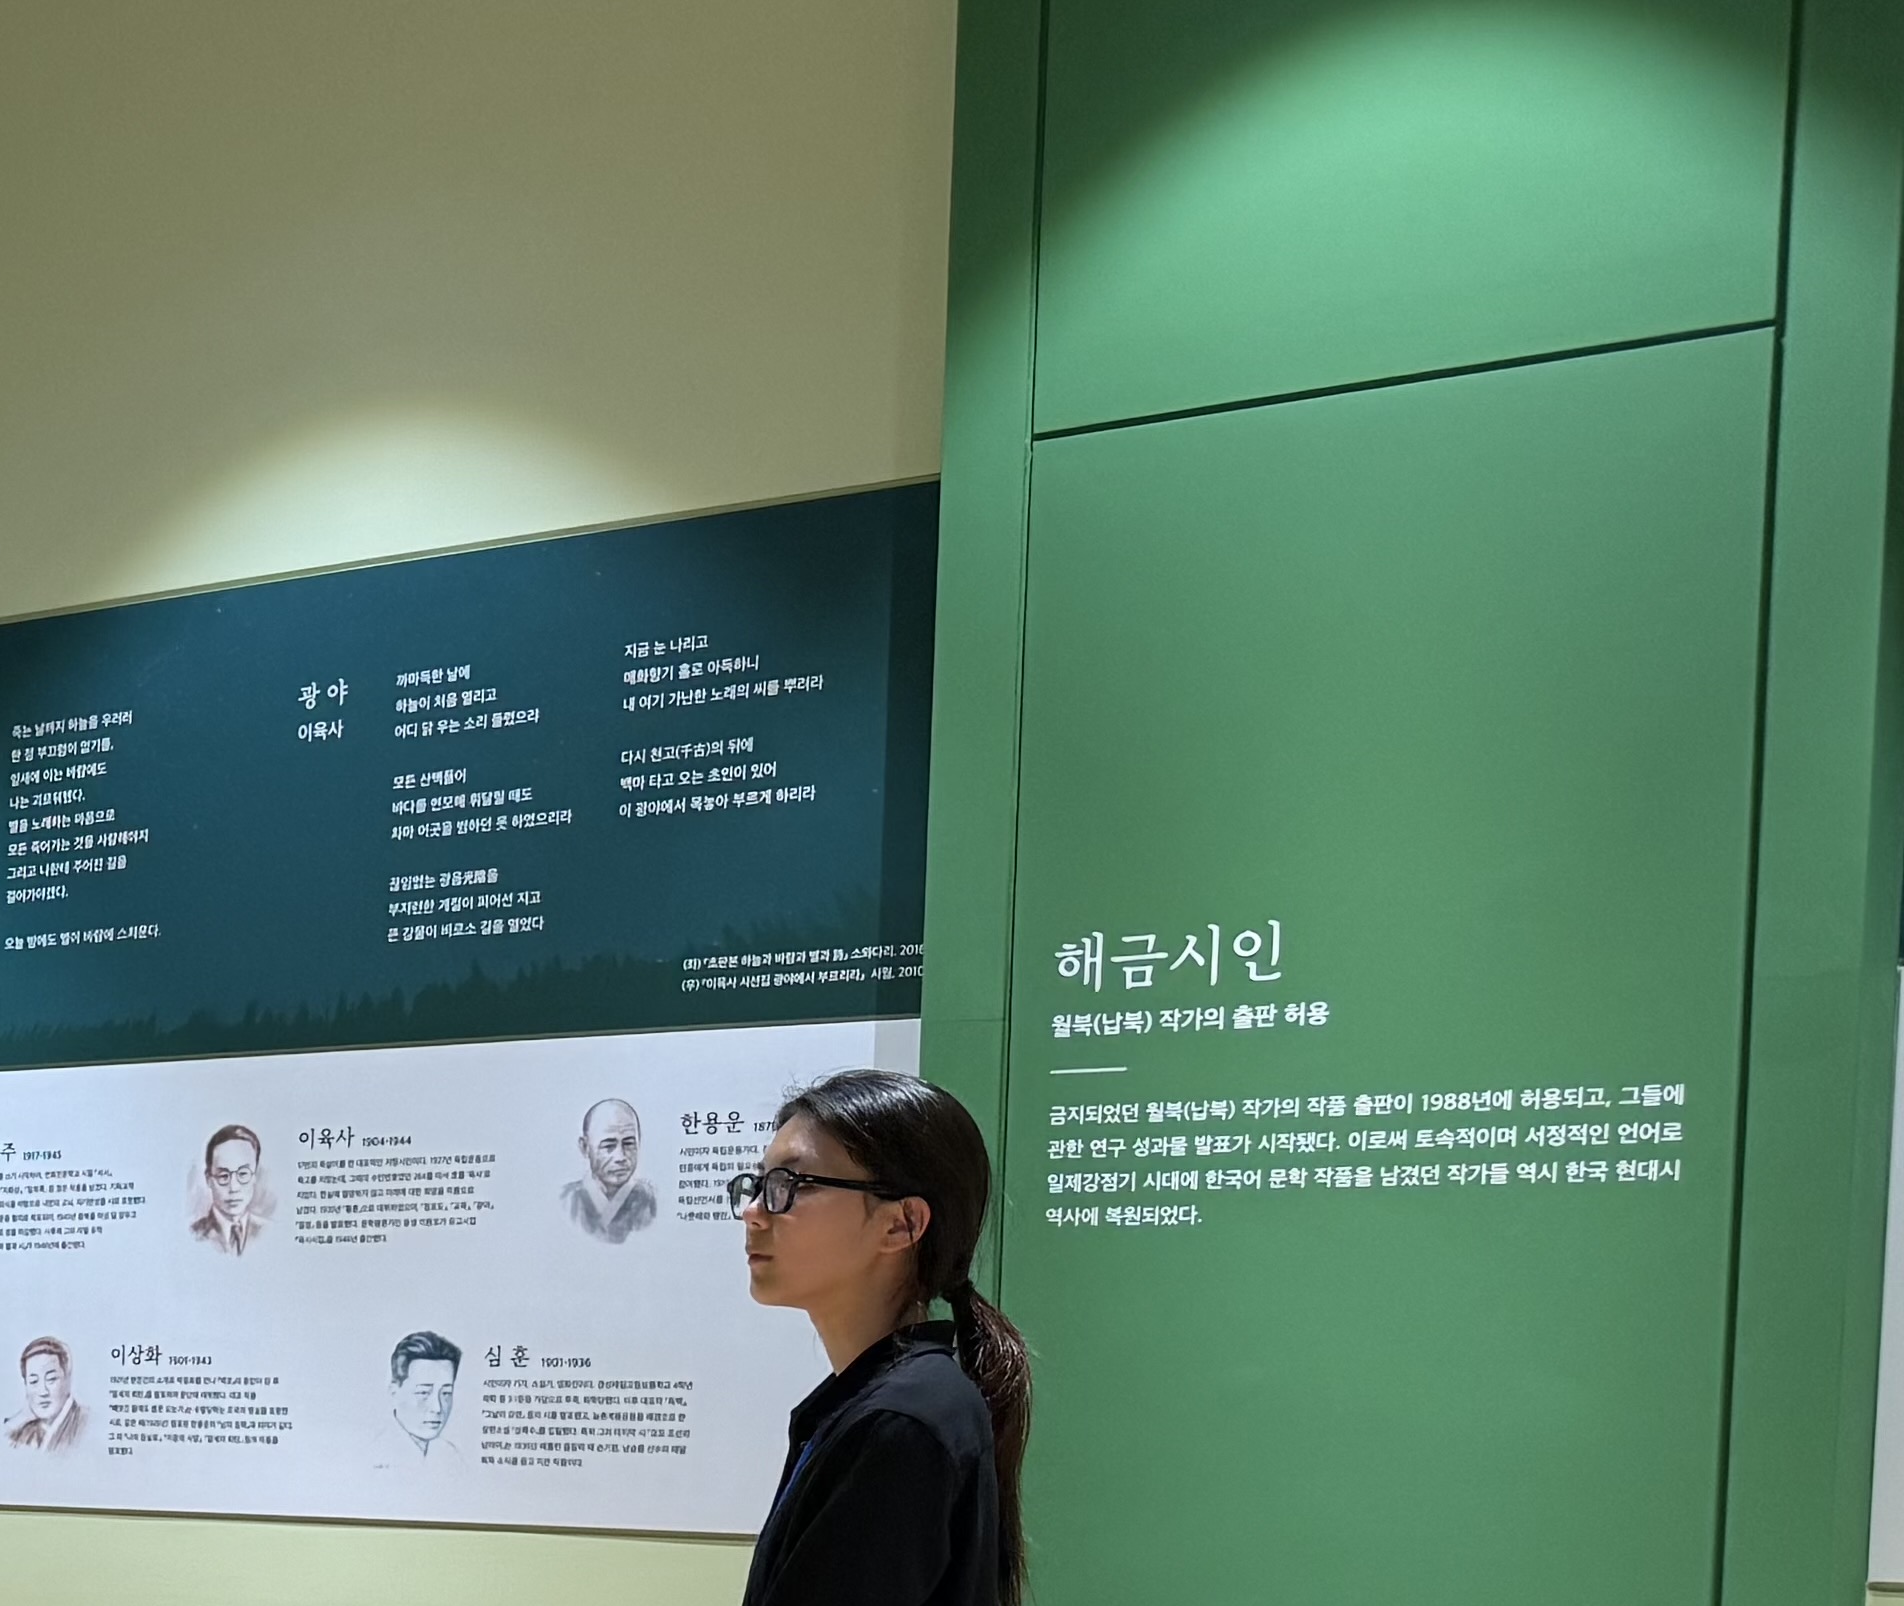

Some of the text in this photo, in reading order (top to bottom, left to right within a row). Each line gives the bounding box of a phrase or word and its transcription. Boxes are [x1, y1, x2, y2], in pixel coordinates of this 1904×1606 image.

[625, 635, 708, 658] 지금 눈 나리고
[396, 664, 470, 688] 까마득한 날에
[679, 662, 703, 680] 홀로
[708, 654, 759, 676] 아득하니
[297, 678, 349, 710] 광 야
[396, 688, 496, 714] 하늘이 처음 열리고
[623, 674, 823, 712] 내 여기 가난한 노래의 씨를 뿌려라
[297, 719, 344, 742] 이육사
[395, 708, 539, 738] 어디 닭 우는 소리 들렸으랴
[621, 748, 646, 766] 다시
[728, 737, 753, 754] 뒤에
[621, 761, 776, 792] 백마 타고 오는 초인이 있어
[619, 784, 815, 818] 이 광야에서 목놓아 부르게 하리라
[1054, 919, 1282, 993] 해금시인
[1052, 1001, 1330, 1038] 월북(납북) 작가의 출판 허용
[1050, 1083, 1684, 1125] 금지되었던 월북(납북) 작가의 작품 출판이 1988년에 허용되고, 그들에
[680, 1111, 745, 1135] 한용운
[298, 1126, 355, 1150] 이육사
[1048, 1121, 1682, 1159] 관한 연구 성과물 발표가 시작됐다. 이로써 토속적이며 서정적인 언어로
[1048, 1159, 1680, 1193] 일제강점기 시대에 한국어 문학 작품을 남겼던 작가들 역시 한국 현대시
[1046, 1205, 1202, 1227] 역사에 복원되었다.
[110, 1344, 163, 1367] 이상화
[484, 1344, 501, 1368] 심
[510, 1344, 530, 1368] 훈
